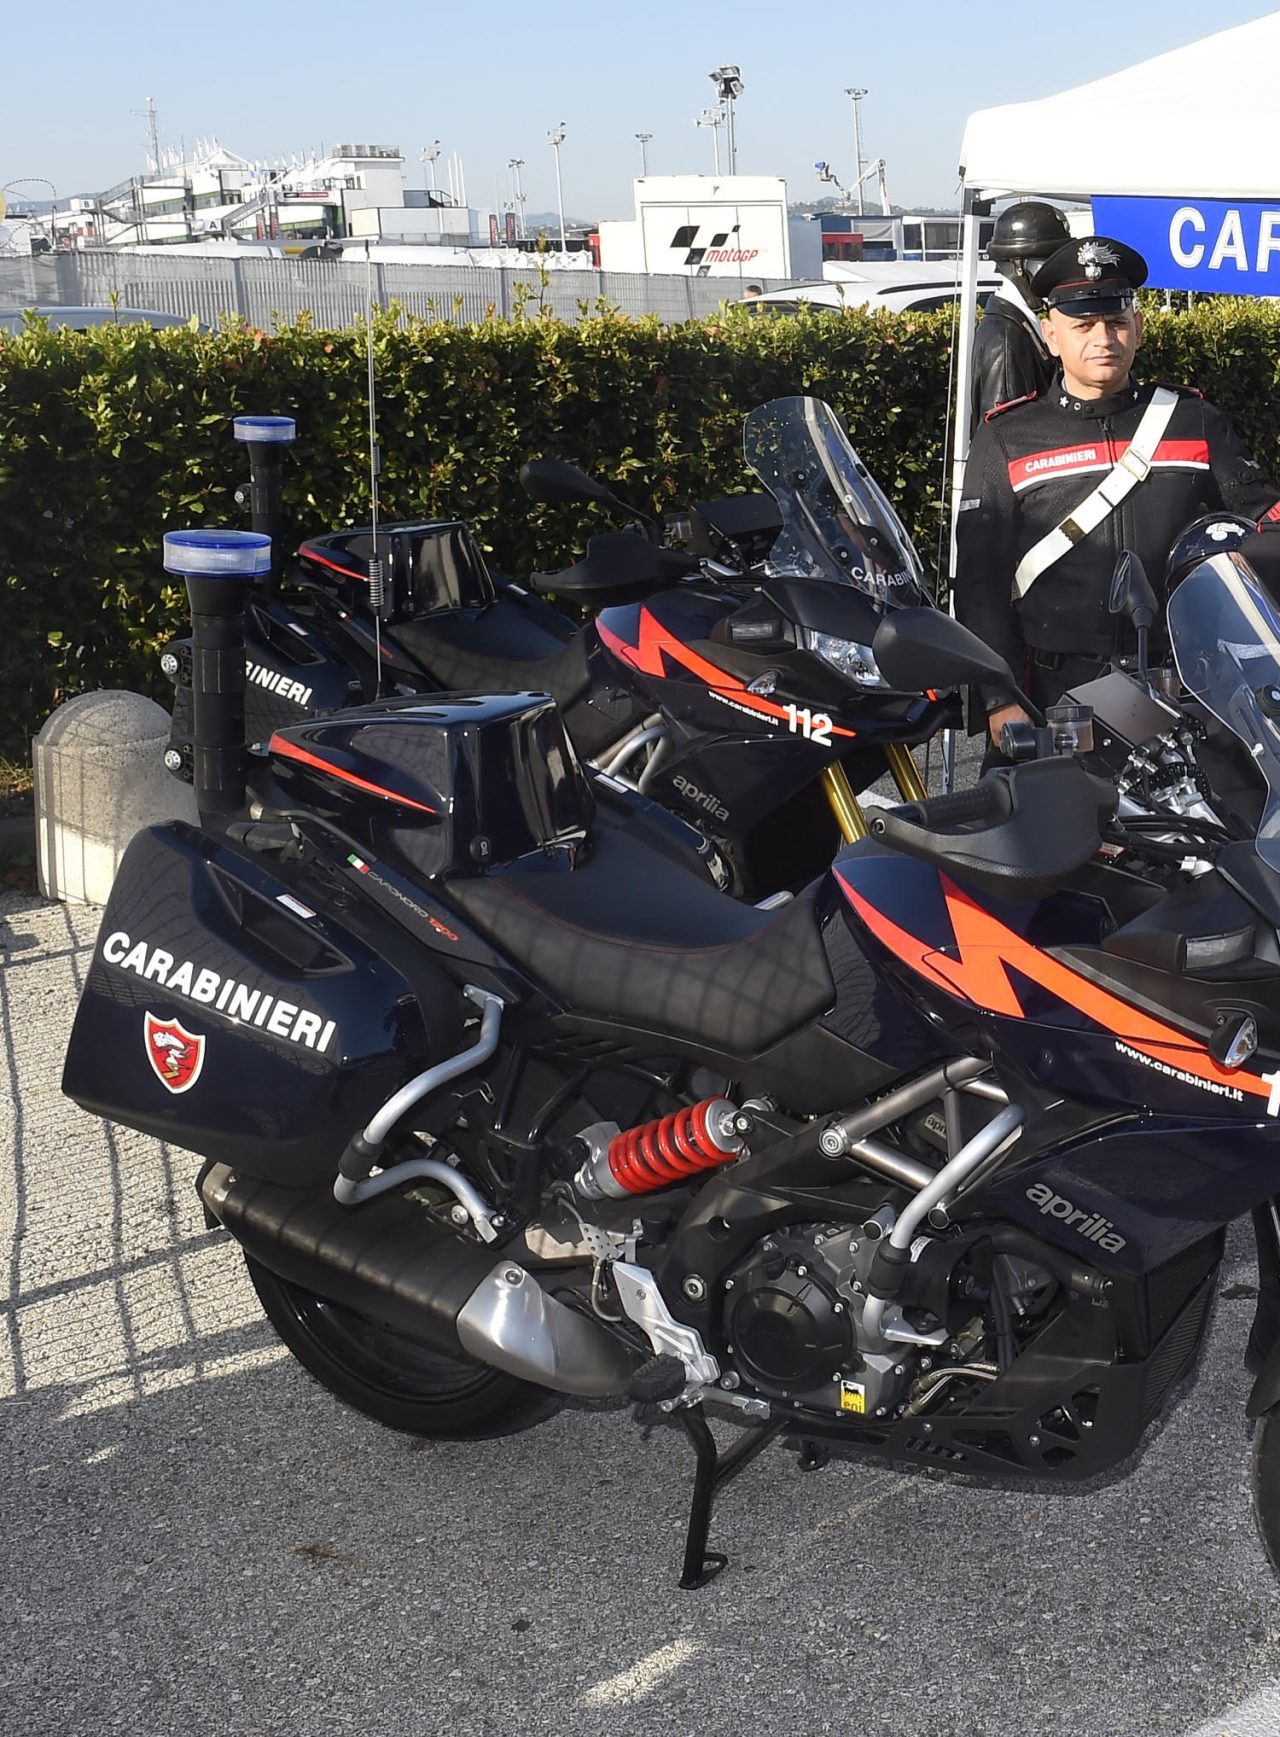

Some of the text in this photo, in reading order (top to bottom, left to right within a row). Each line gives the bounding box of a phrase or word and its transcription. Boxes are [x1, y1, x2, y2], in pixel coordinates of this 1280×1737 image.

[1025, 449, 1097, 473] CARABINIERI
[782, 703, 833, 748] 112
[672, 775, 730, 821] aprilia
[103, 931, 337, 1053] CARABINIERI
[1114, 1040, 1244, 1102] www.carabinieri.it
[1025, 1183, 1127, 1254] aprilia
[843, 1401, 862, 1413] eni
